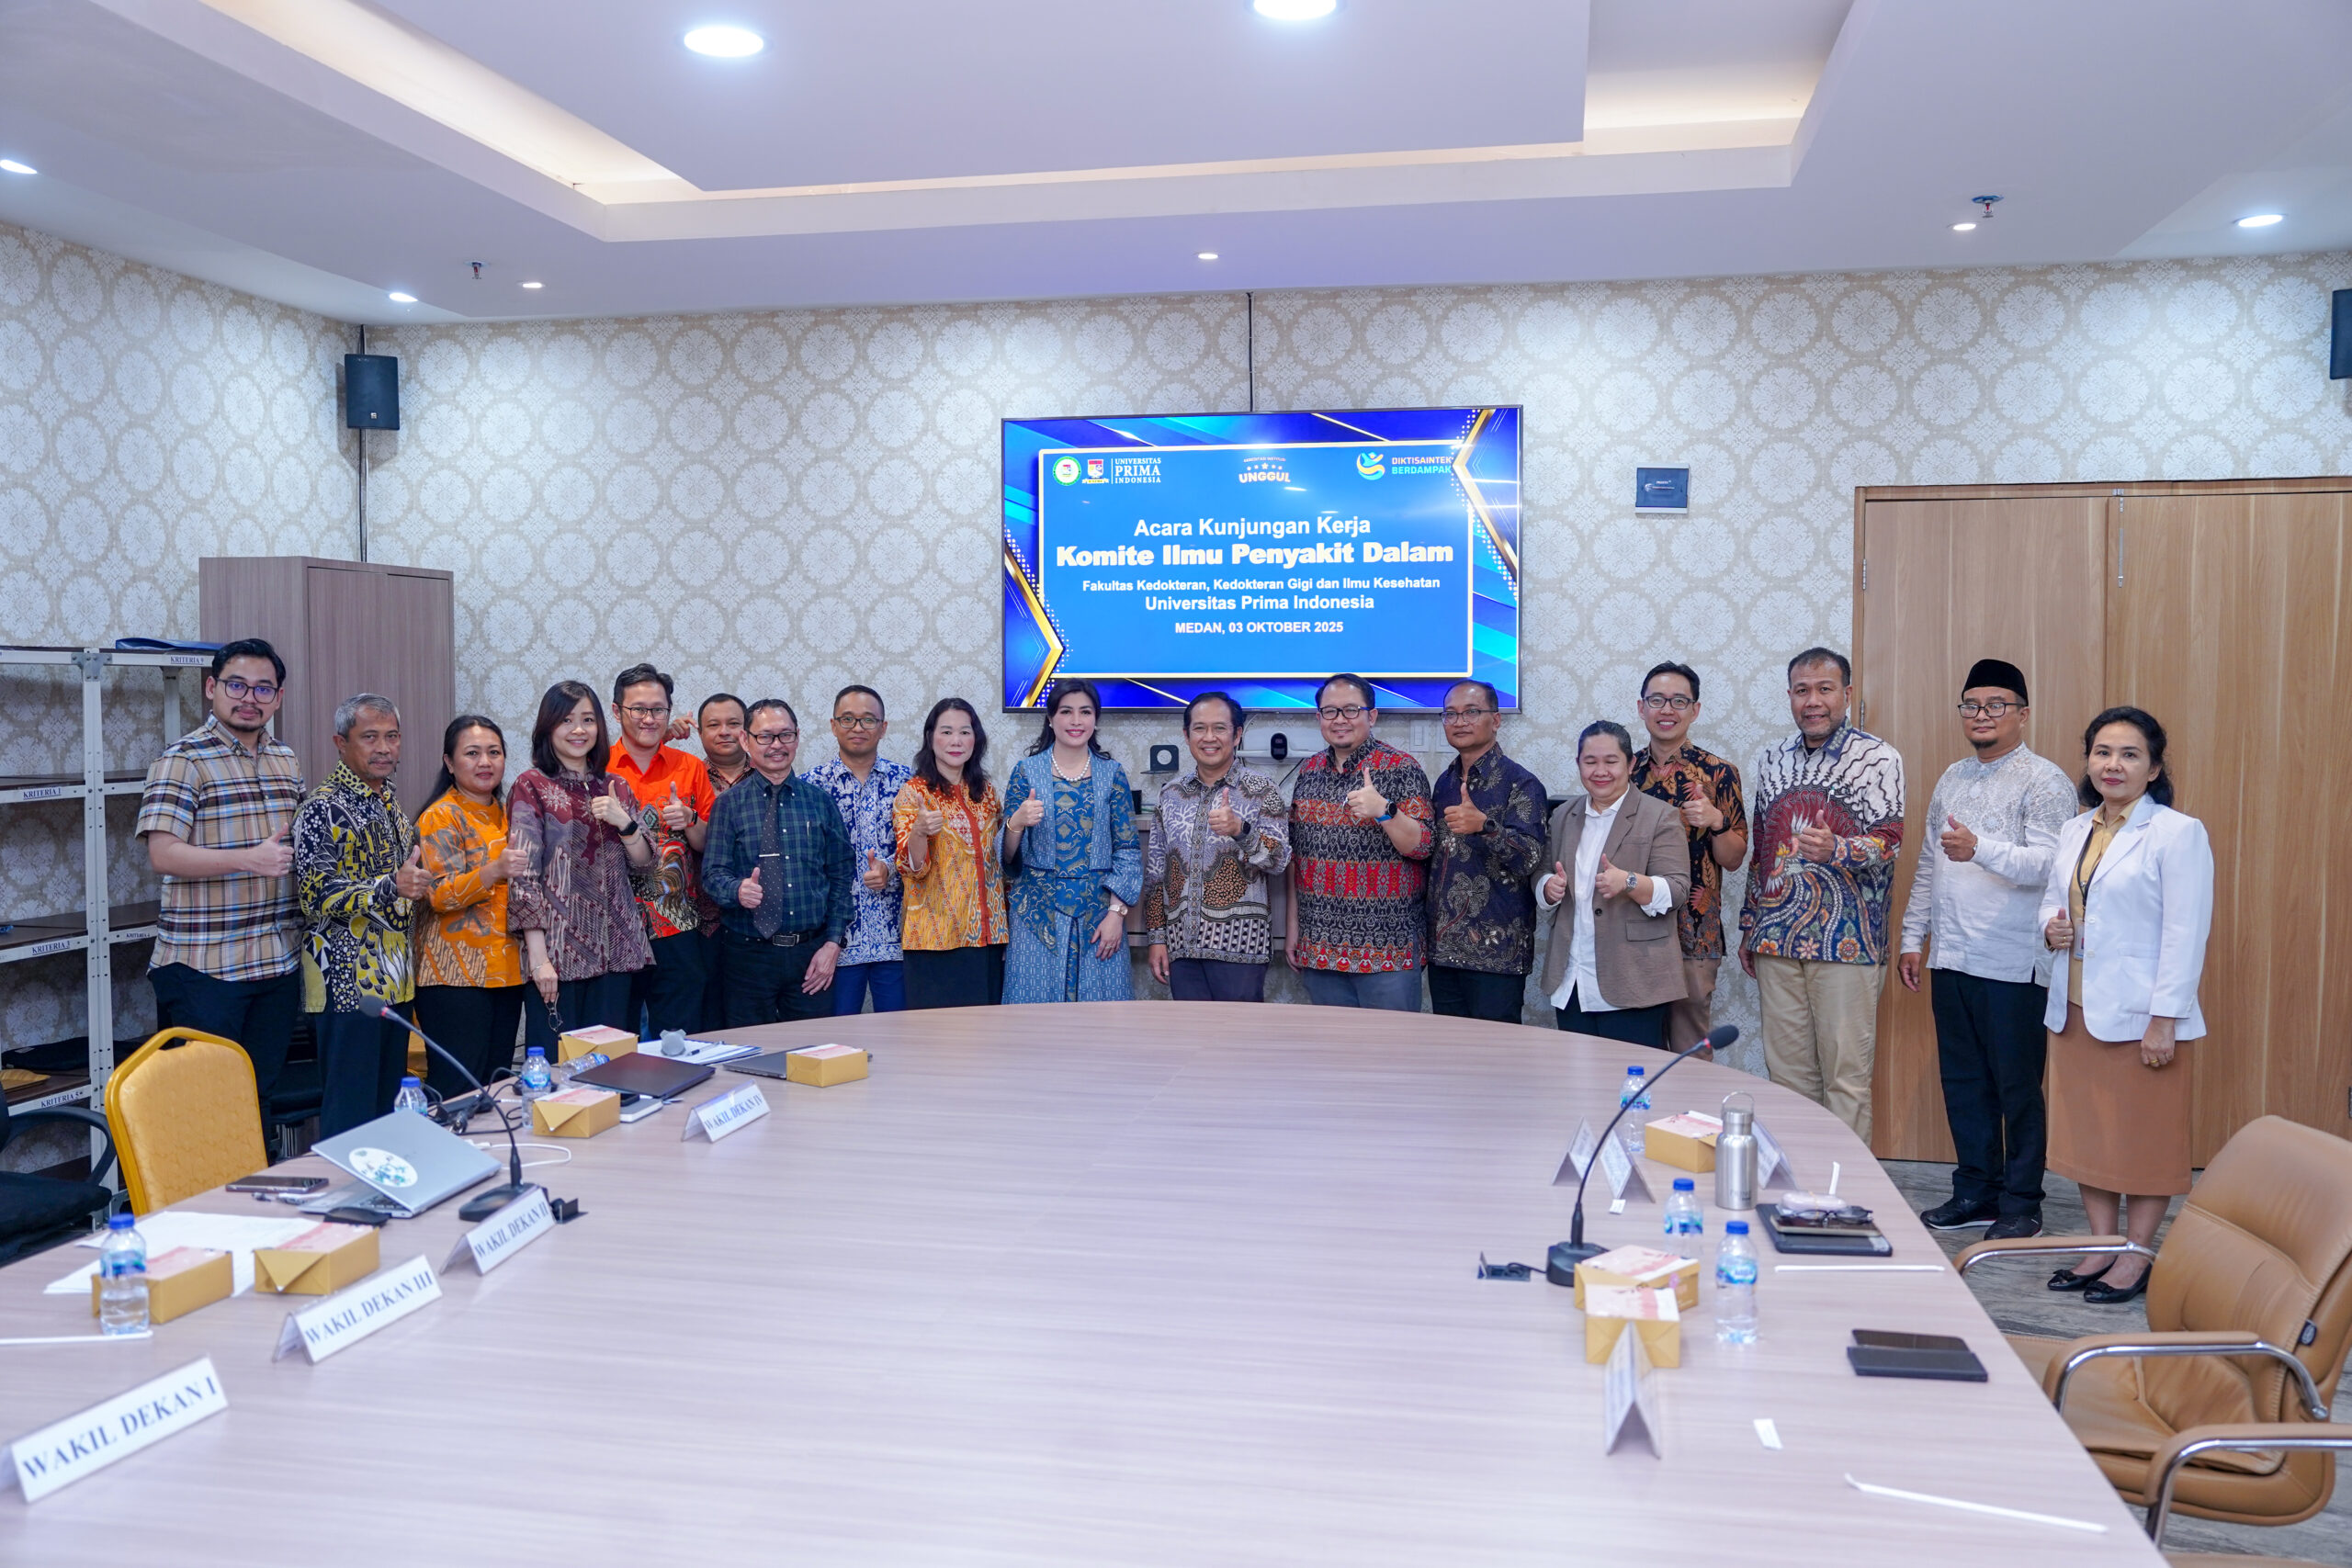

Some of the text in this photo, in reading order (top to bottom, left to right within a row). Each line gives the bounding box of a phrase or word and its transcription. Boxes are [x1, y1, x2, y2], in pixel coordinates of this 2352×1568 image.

[1391, 457, 1453, 465] DIKTISAINTEK
[1114, 465, 1161, 477] PRIMA
[1238, 471, 1291, 484] UNGGUL
[1391, 465, 1452, 475] BERDAMPAK
[1134, 516, 1371, 539] Acara Kunjungan Kerja
[1057, 541, 1453, 570] Komite Ilmu Penyakit Dalam
[1082, 577, 1441, 592] Fakultas Kedokteran, Kedokteran Gigi dan Ilmu Kesehatan
[1146, 594, 1374, 611] Universitas Prima Indonesia
[1175, 622, 1344, 635] MEDAN, 03 OKTOBER 2025
[23, 788, 57, 798] KRITERIA
[32, 942, 65, 953] KRITERIA
[40, 1093, 74, 1108] KRITERIA
[703, 1111, 732, 1131] WAKIL
[729, 1098, 754, 1119] DEKAN
[474, 1201, 548, 1258] WAKIL DEKAN II
[305, 1270, 434, 1344] WAKIL DEKAN III
[23, 1376, 217, 1480] WAKIL DEKAN I
